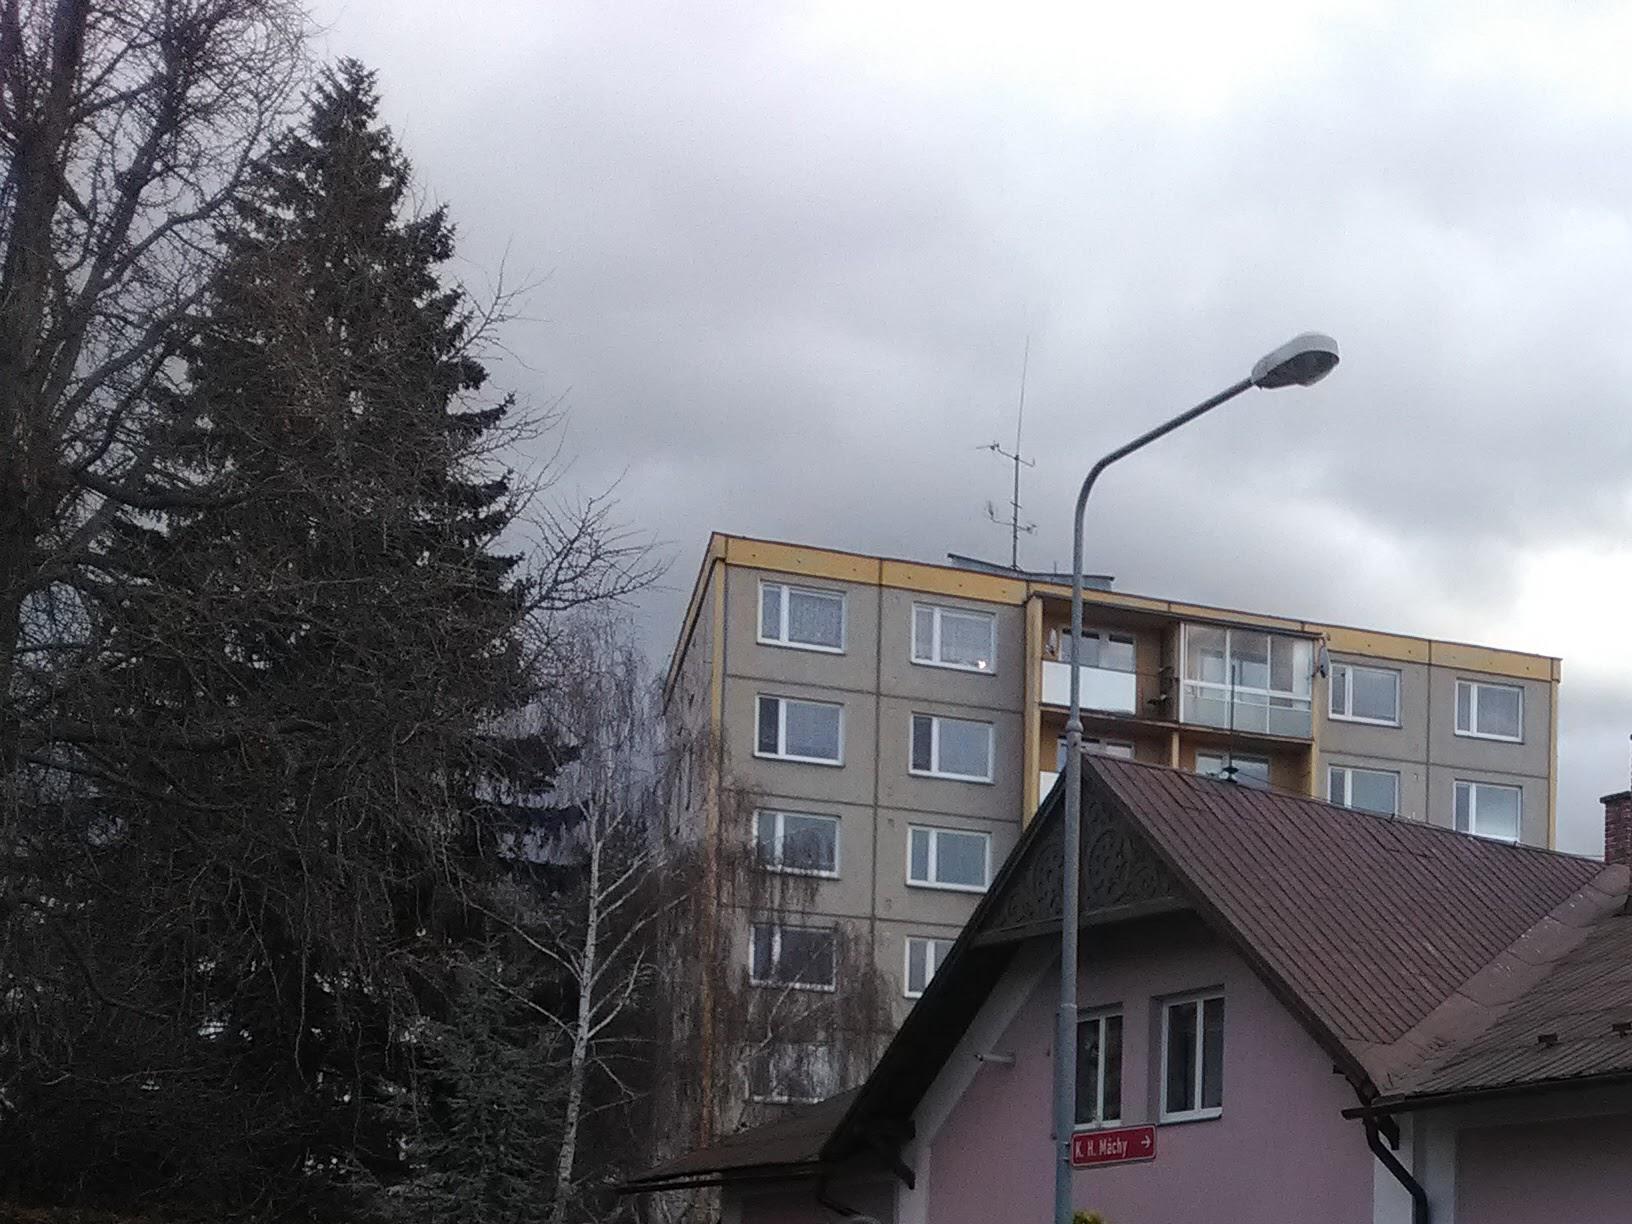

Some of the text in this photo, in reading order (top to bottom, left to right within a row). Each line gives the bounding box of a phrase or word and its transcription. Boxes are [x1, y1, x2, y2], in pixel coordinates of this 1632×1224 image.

[1075, 1136, 1128, 1158] K. H. Máchy
